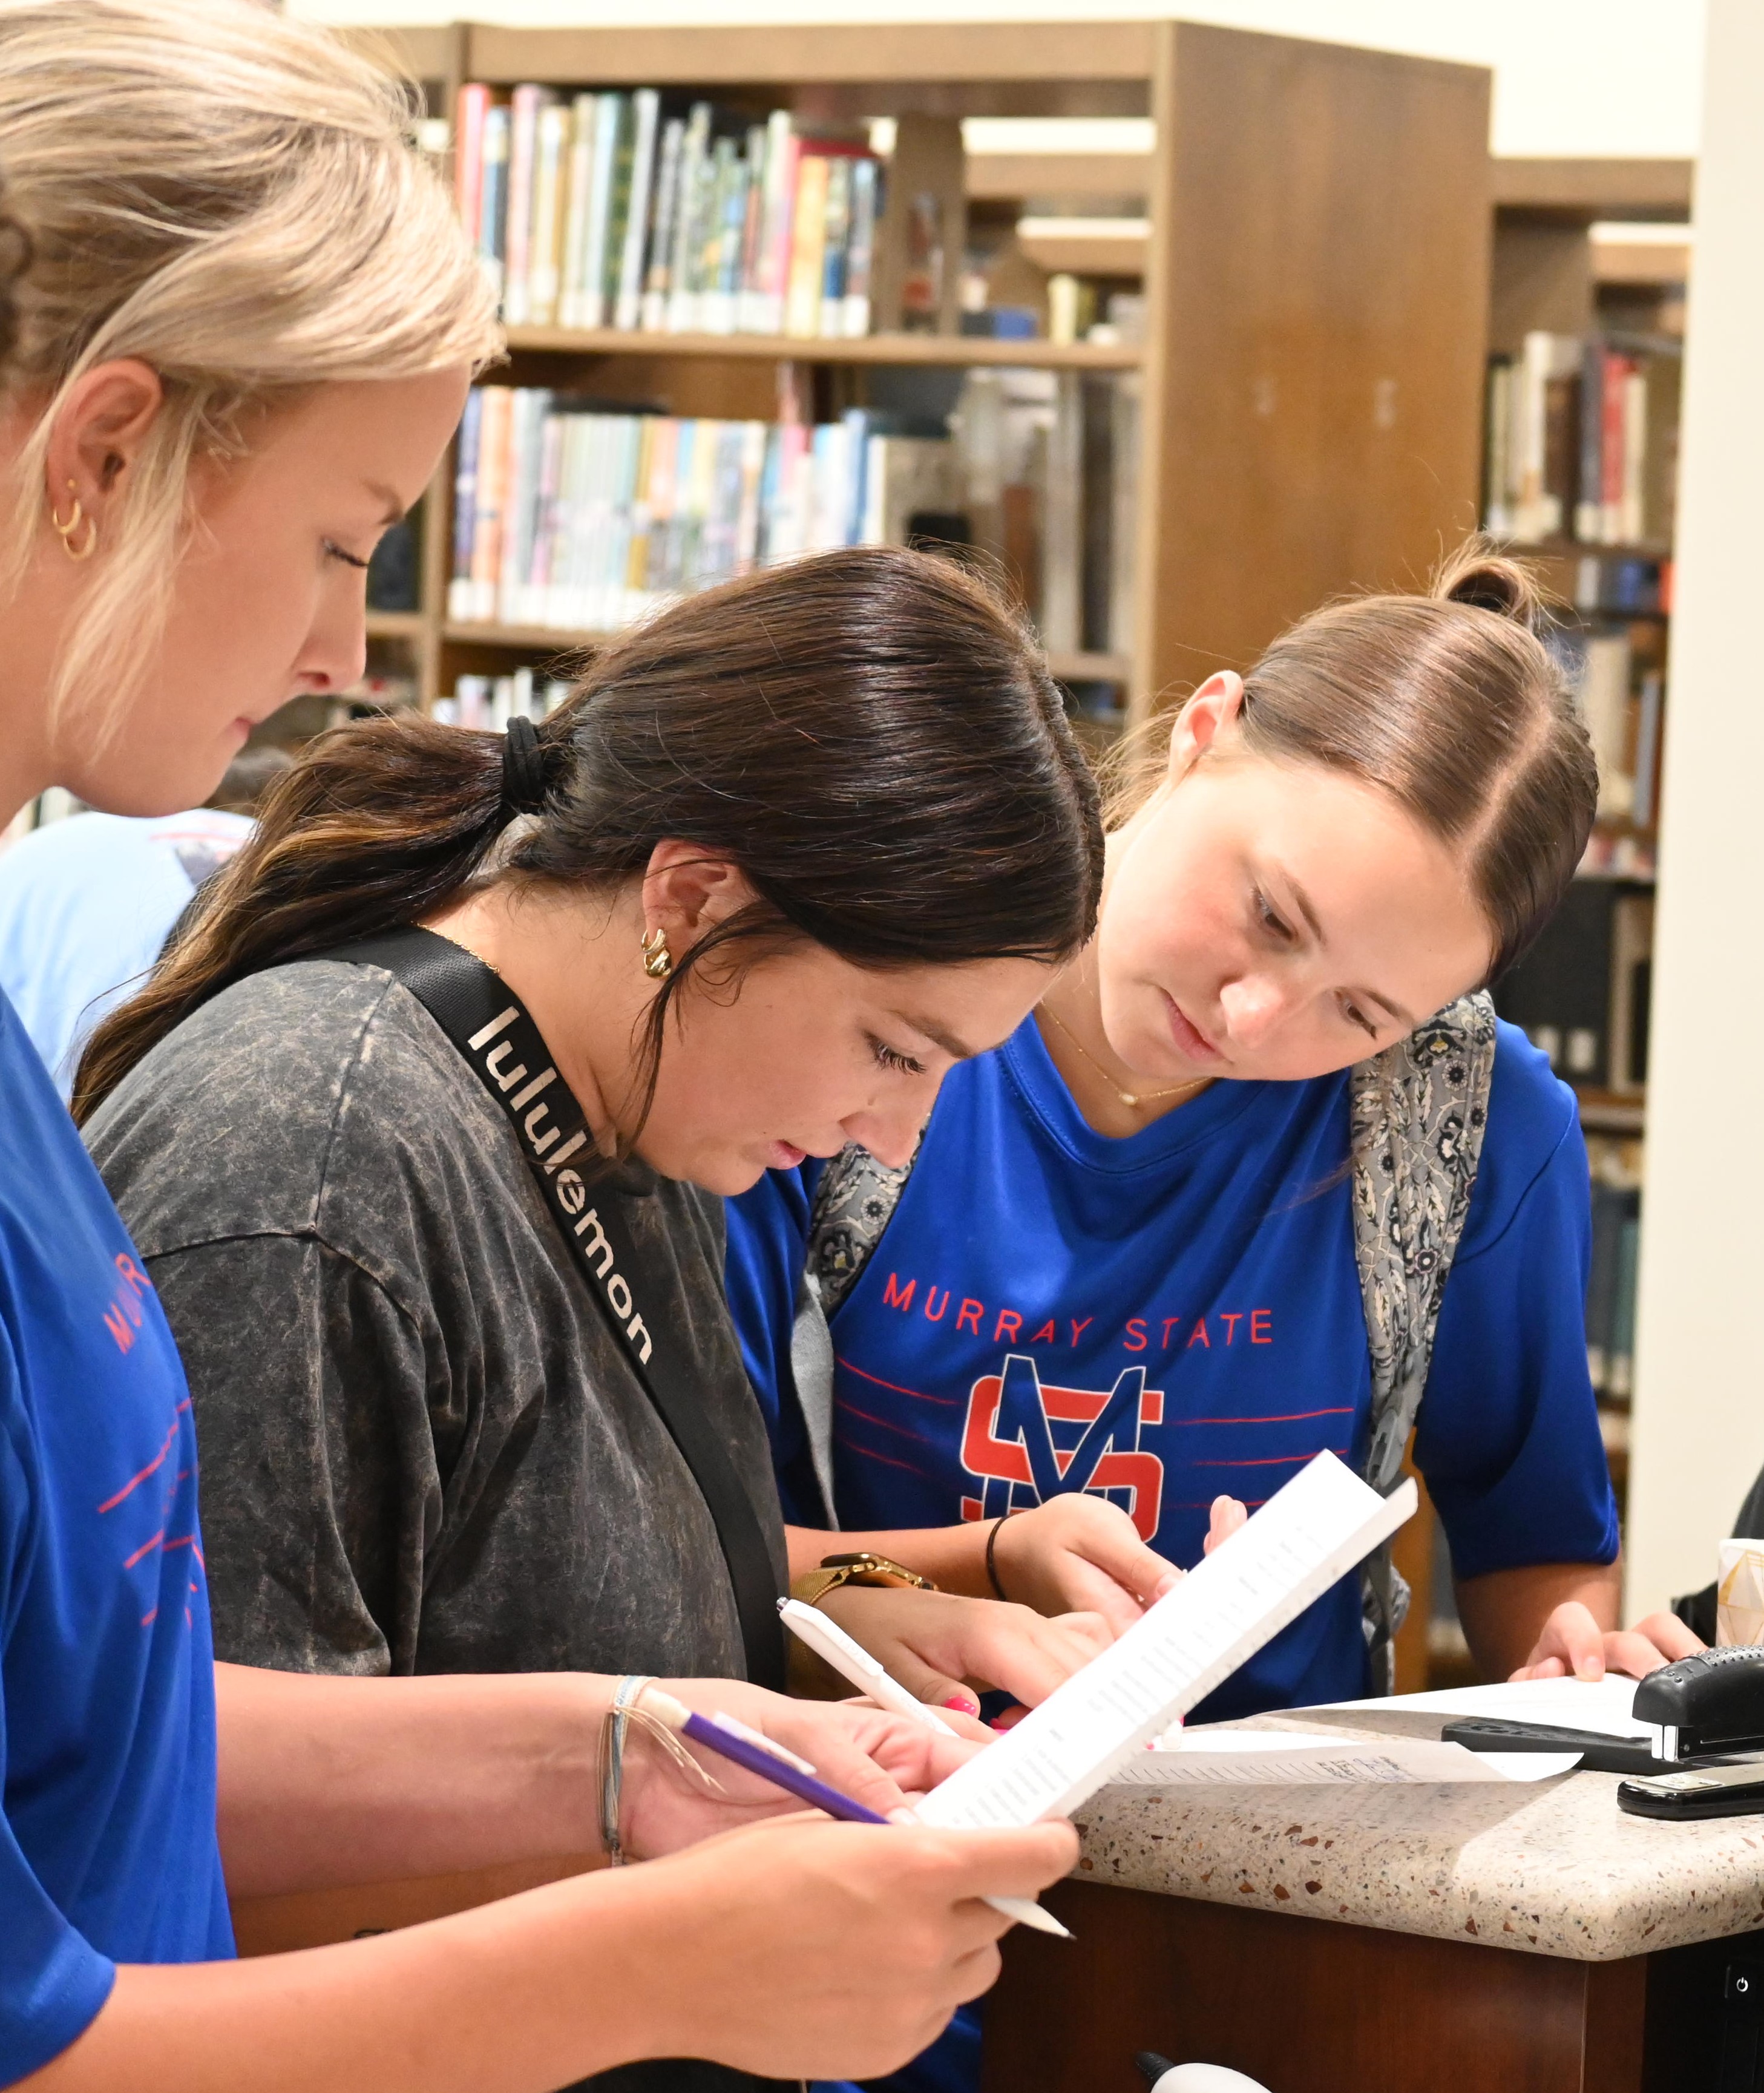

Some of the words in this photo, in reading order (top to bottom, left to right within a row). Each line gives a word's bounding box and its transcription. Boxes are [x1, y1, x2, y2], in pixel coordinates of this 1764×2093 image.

[467, 1005, 652, 1365] lululemon
[882, 1273, 1093, 1348] MURRAY
[1123, 1309, 1273, 1351] STATE
